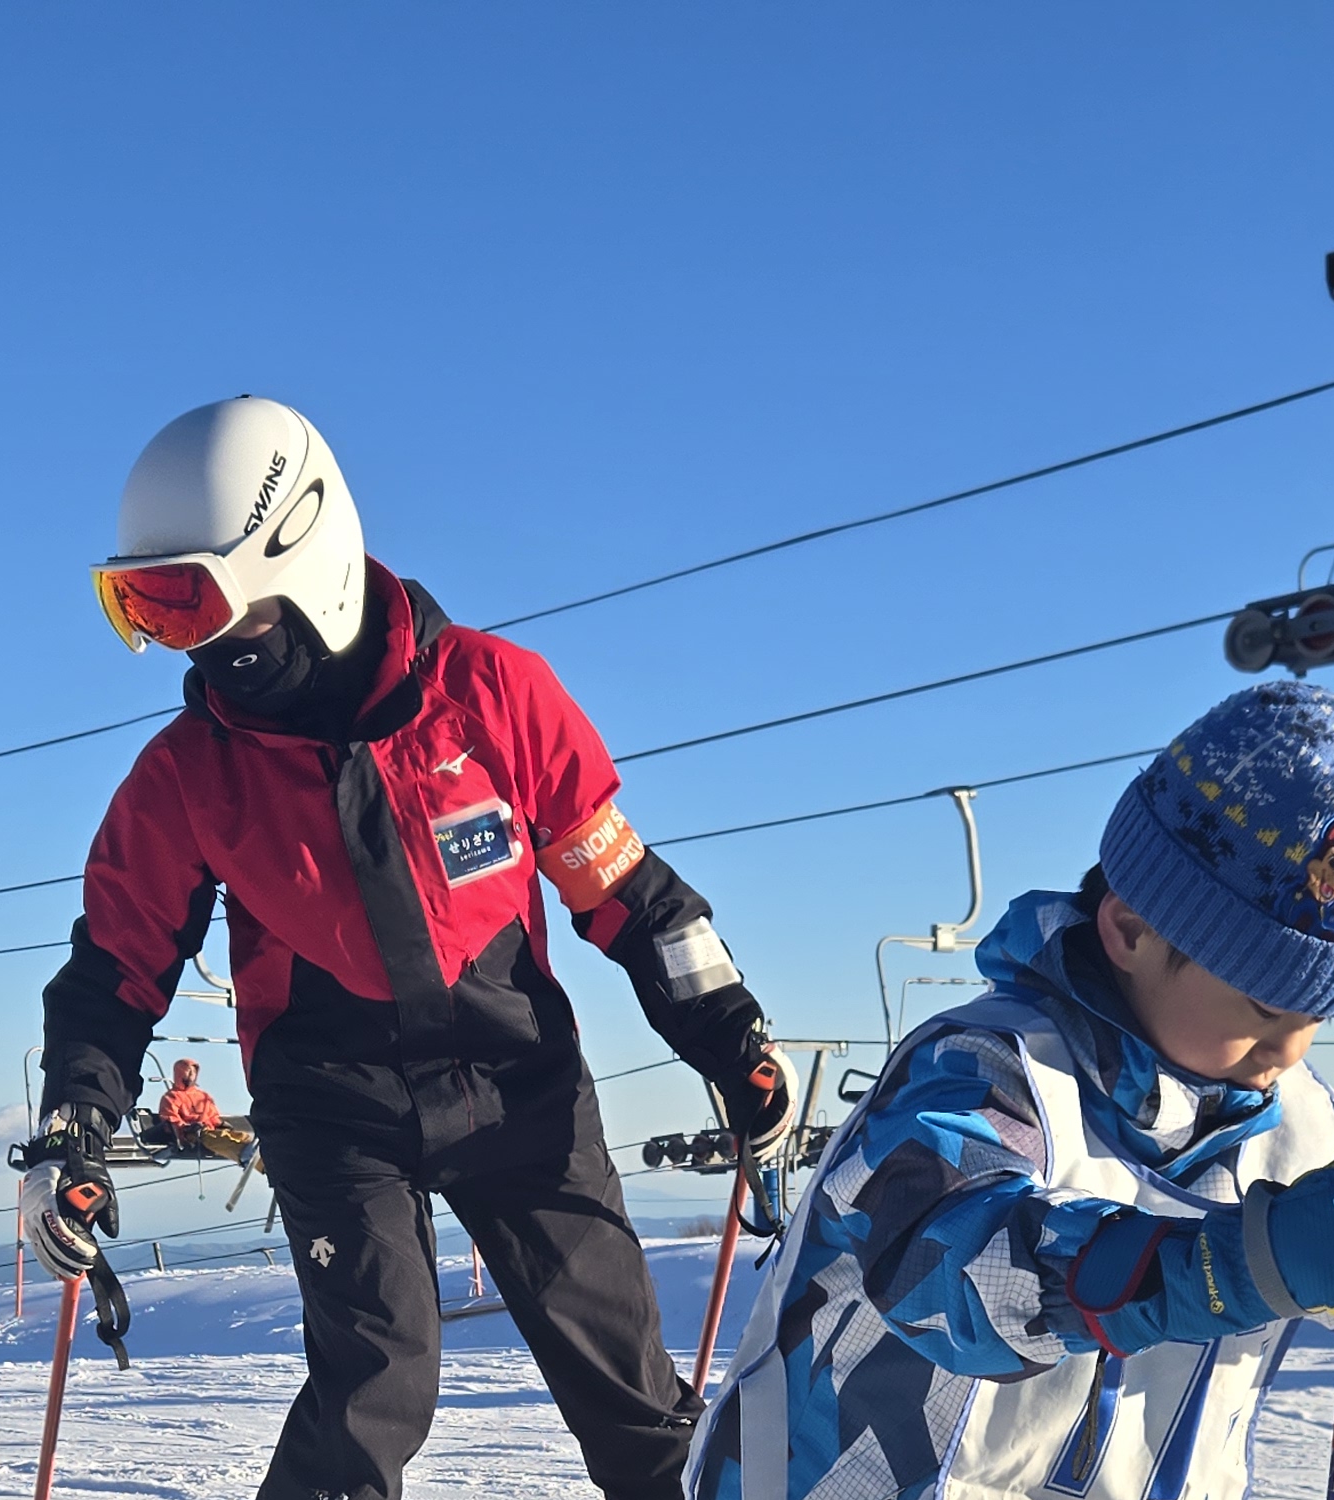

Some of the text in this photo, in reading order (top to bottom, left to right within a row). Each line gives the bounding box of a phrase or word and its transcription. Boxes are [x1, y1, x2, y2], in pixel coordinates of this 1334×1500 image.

[244, 449, 287, 537] SWANS
[448, 829, 495, 854] せりざわ
[561, 817, 618, 870] SNOW
